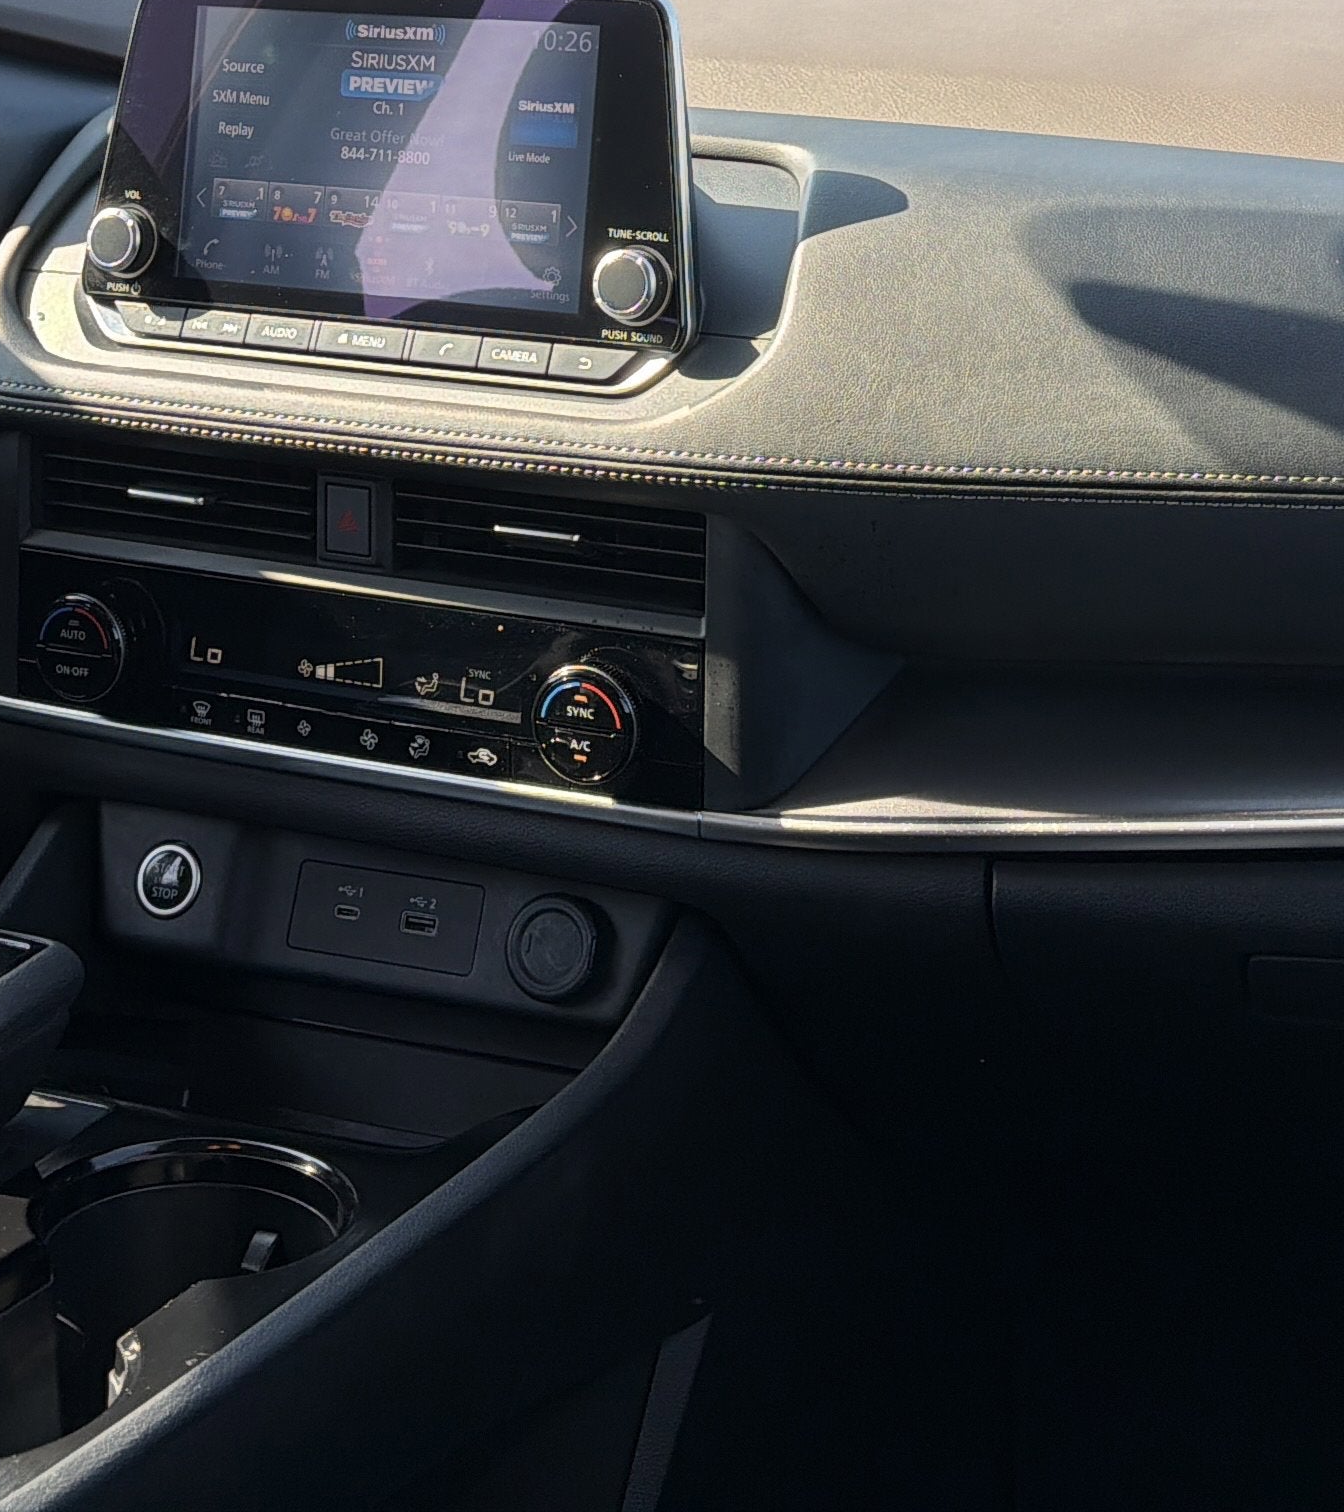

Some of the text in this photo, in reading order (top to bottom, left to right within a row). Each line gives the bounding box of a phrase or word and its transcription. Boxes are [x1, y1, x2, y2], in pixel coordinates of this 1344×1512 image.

[222, 58, 265, 74] Source
[351, 51, 436, 72] SIRIUSXM
[349, 76, 434, 95] PREVIEW
[212, 89, 270, 106] SXM Menu
[373, 101, 404, 116] Ch. 1
[518, 100, 575, 115] SiriusXM
[218, 121, 255, 139] Replay
[330, 128, 368, 143] Great
[370, 129, 405, 144] Offer
[340, 146, 431, 165] 844-711-8800
[508, 151, 551, 165] Live Mode
[124, 190, 142, 200] VOL
[274, 190, 281, 200] 8
[314, 191, 322, 204] 7
[330, 194, 338, 205] 9
[364, 194, 378, 208] 14
[505, 207, 517, 219] 12
[263, 265, 280, 276] AM
[315, 269, 330, 280] FM
[106, 281, 129, 293] PUSH
[530, 289, 570, 304] Settings
[261, 326, 297, 339] AUDIO
[601, 329, 663, 344] PUSH SOUND
[352, 335, 386, 349] MENU
[492, 348, 537, 364] CAMERA
[60, 629, 86, 640] AUTO
[190, 636, 222, 664] Lo
[468, 668, 491, 680] SYNC
[460, 677, 494, 706] Lo
[566, 705, 594, 720] SYNC
[191, 716, 212, 726] FRONT
[247, 726, 265, 735] REAR
[570, 739, 591, 752] A/C
[151, 886, 178, 900] STOP
[430, 899, 437, 910] 2
